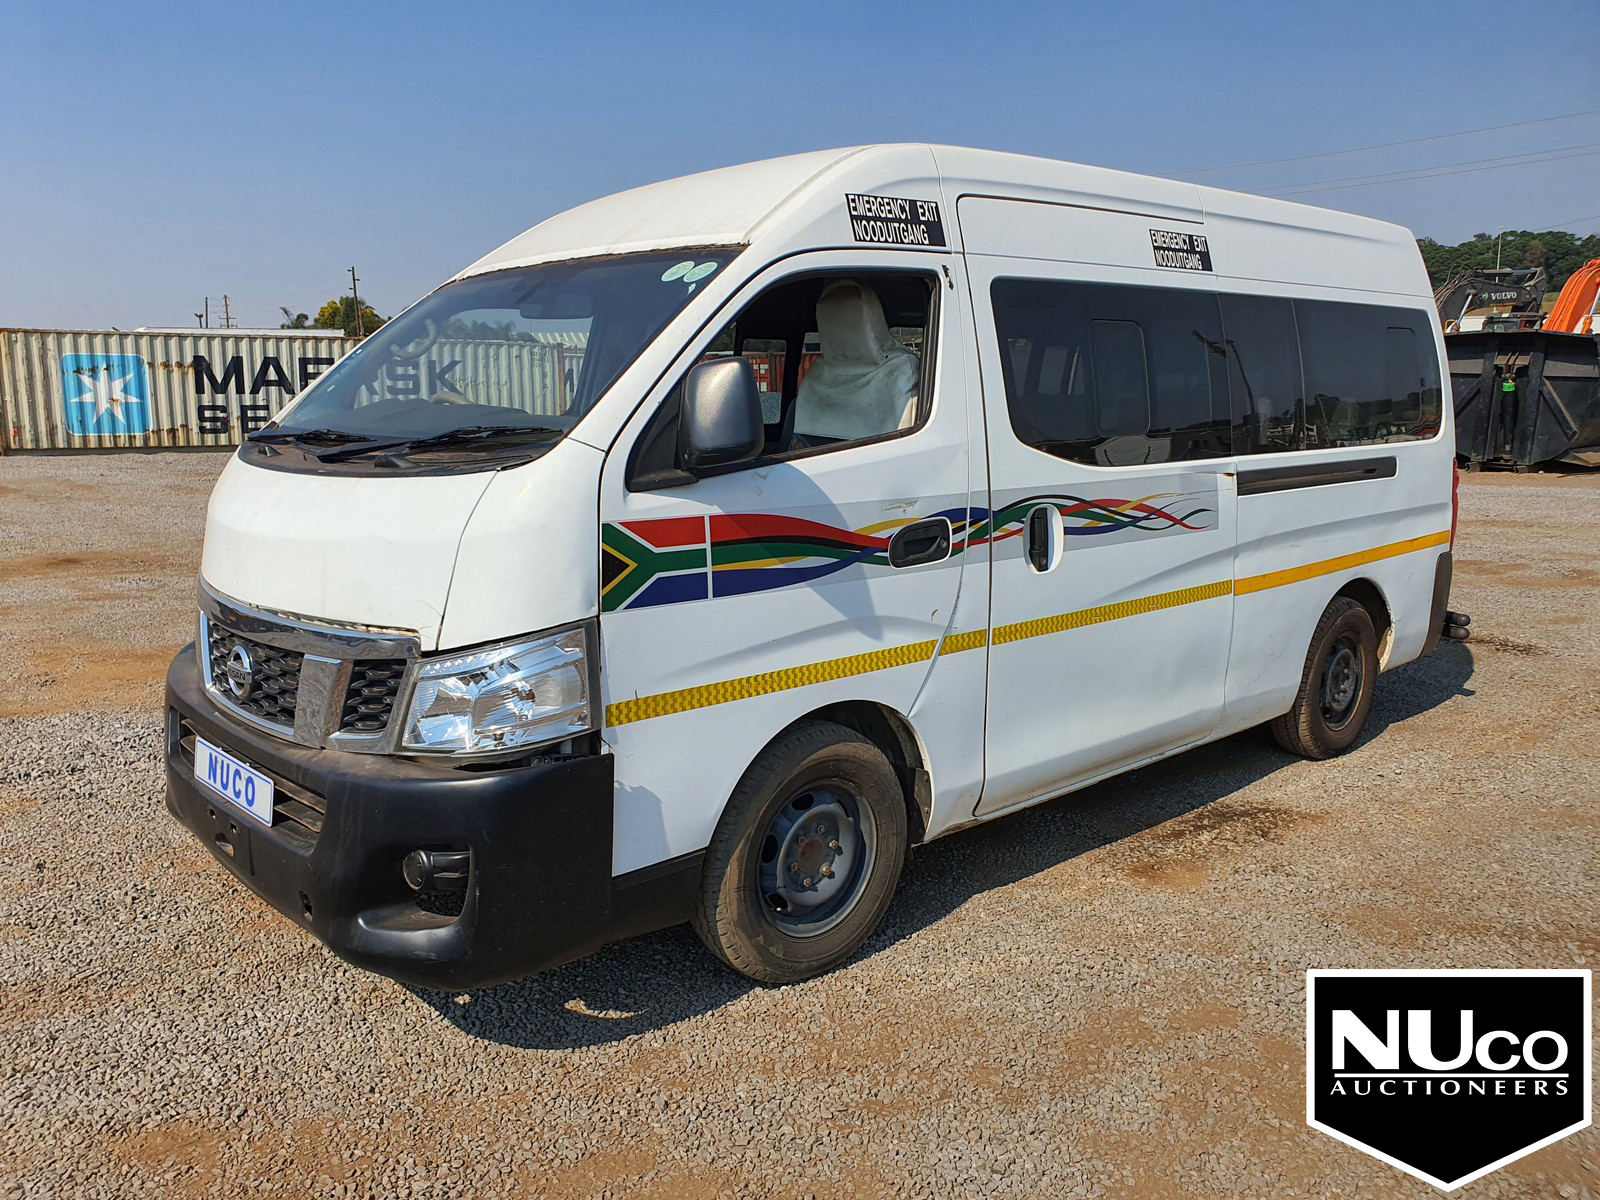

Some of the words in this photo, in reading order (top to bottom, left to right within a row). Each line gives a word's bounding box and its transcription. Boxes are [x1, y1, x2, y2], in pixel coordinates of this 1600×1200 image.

[848, 194, 911, 219] EMERGENCY
[917, 201, 938, 222] EXIT
[853, 219, 929, 245] NOODUITGANG
[1151, 230, 1190, 250] EMERGENCY
[1193, 236, 1207, 252] EXIT
[1155, 249, 1202, 270] NOODUITGANG
[1491, 291, 1517, 300] VOLVO
[208, 752, 255, 807] NUCO
